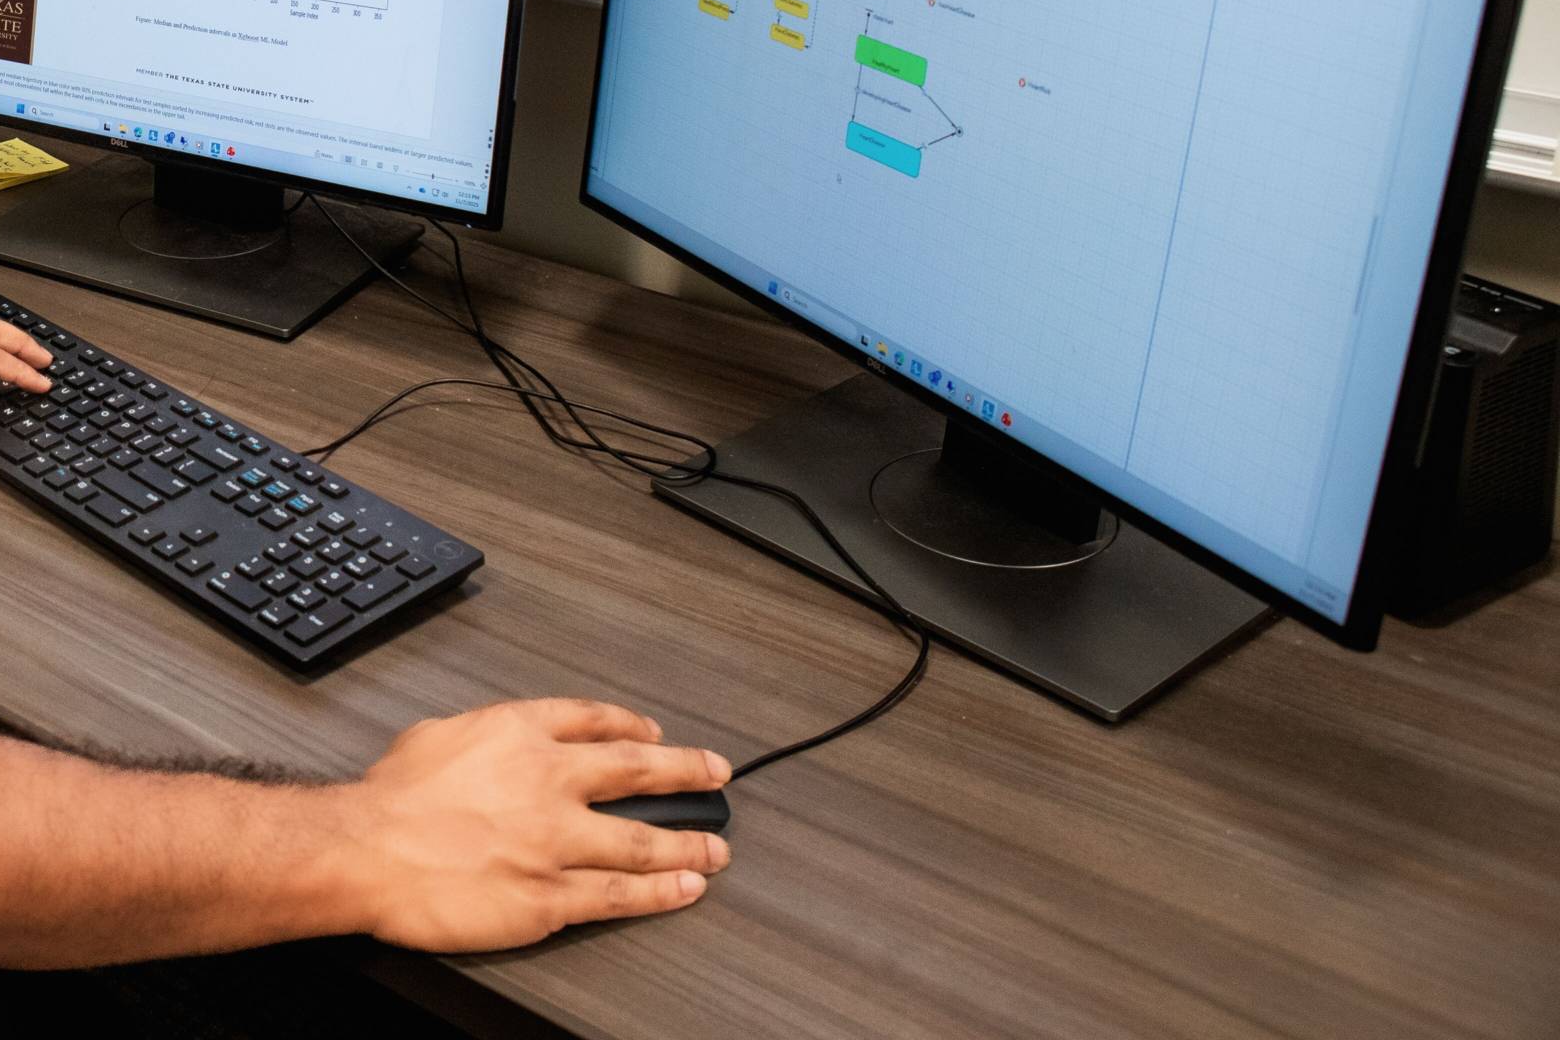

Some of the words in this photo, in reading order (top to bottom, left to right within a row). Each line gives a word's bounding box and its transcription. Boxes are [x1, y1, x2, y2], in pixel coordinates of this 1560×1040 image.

[166, 73, 179, 81] THE
[182, 76, 205, 85] TEXAS
[208, 81, 230, 90] STATE
[233, 85, 278, 98] UNIVERSITY
[110, 137, 129, 149] DELL
